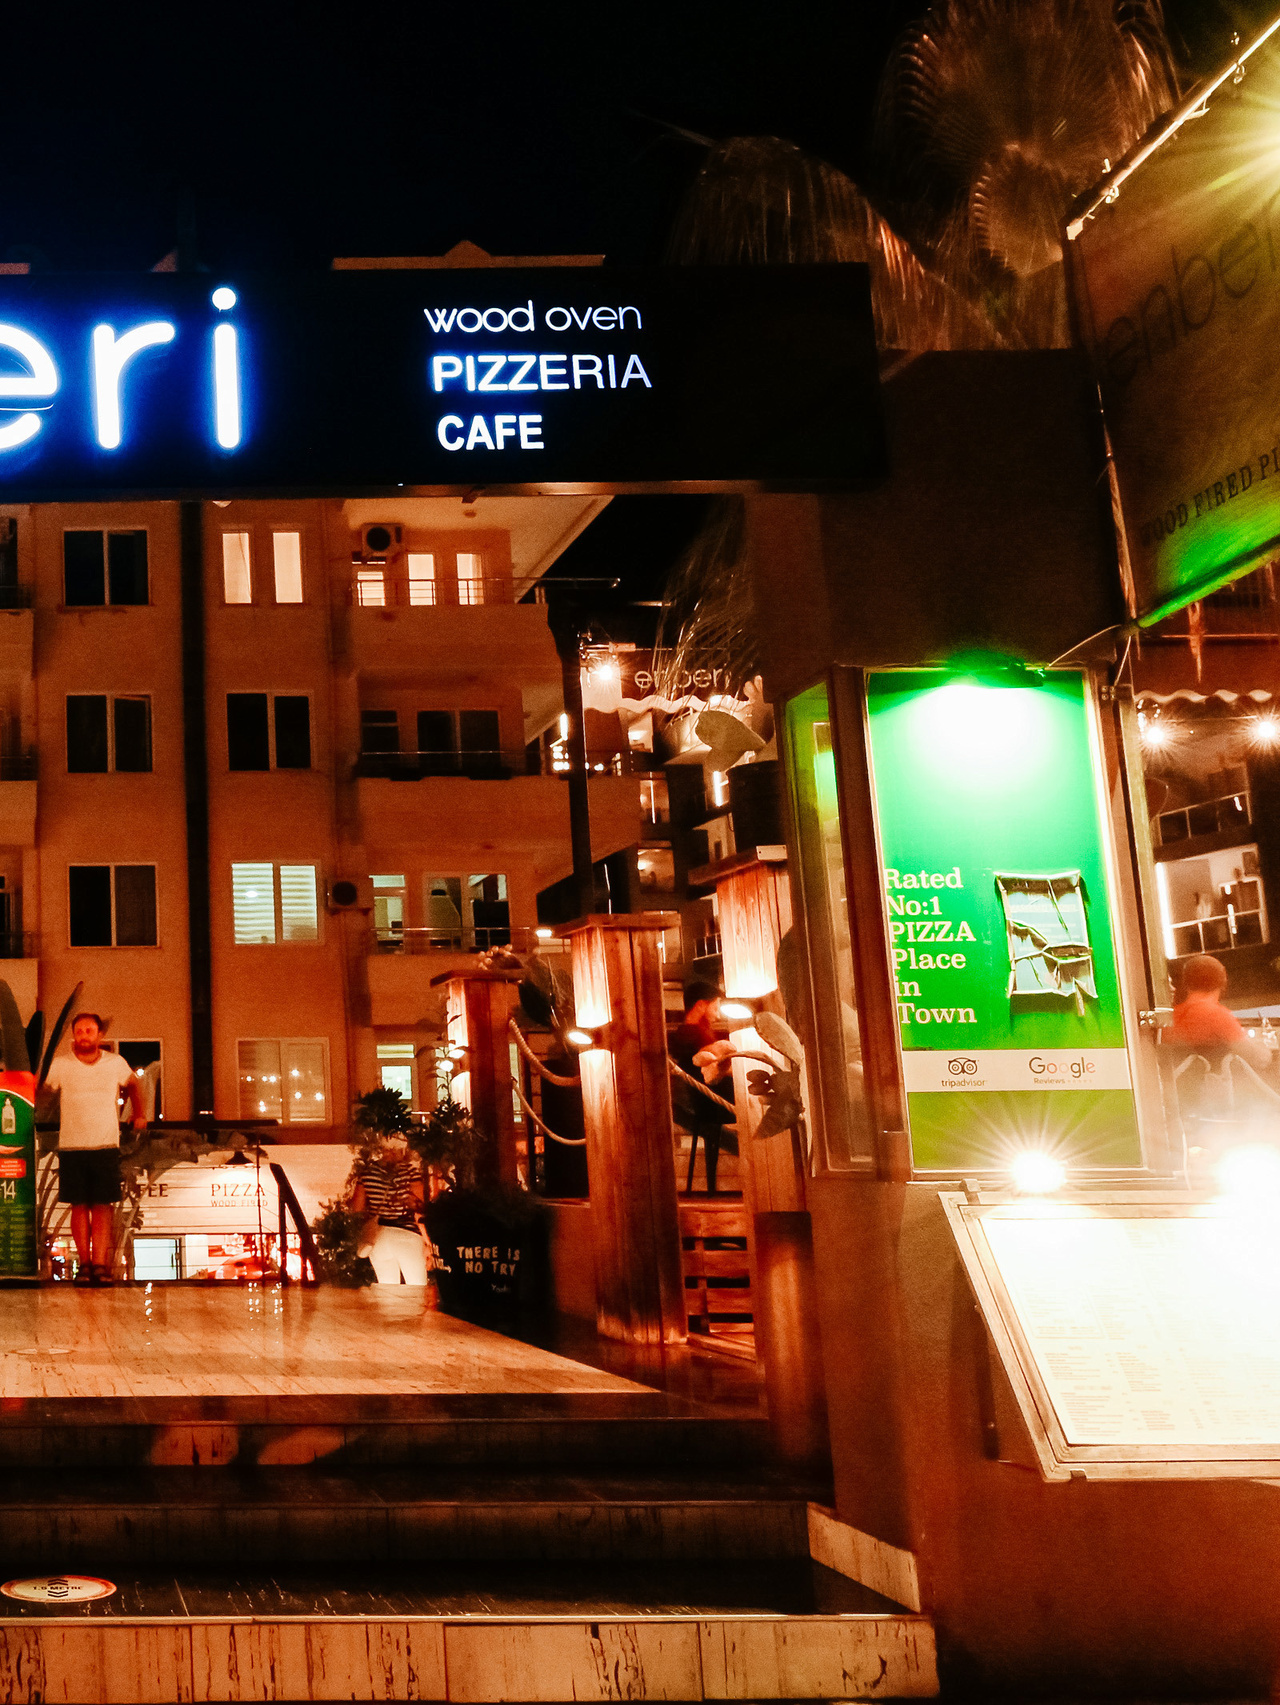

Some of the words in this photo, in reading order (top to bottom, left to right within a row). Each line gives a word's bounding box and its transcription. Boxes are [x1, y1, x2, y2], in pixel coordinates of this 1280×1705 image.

[424, 300, 535, 333] wood
[545, 305, 642, 332] oven
[432, 354, 652, 392] PIZZERIA
[437, 414, 545, 451] CAFE
[1193, 465, 1252, 517] FIRED
[884, 866, 964, 889] Rated
[886, 895, 943, 916] No:1
[889, 920, 977, 942] PIZZA
[892, 947, 967, 970] Place
[894, 974, 922, 996] in
[897, 1002, 978, 1024] Town
[1028, 1056, 1096, 1079] Google
[941, 1078, 986, 1087] tripadvisor
[1033, 1077, 1066, 1085] Reviews
[0, 1179, 17, 1199] 14
[211, 1183, 266, 1197] PIZZA
[456, 1245, 498, 1259] THERE
[507, 1247, 521, 1261] IS
[465, 1260, 483, 1273] NO
[491, 1261, 516, 1277] TRY
